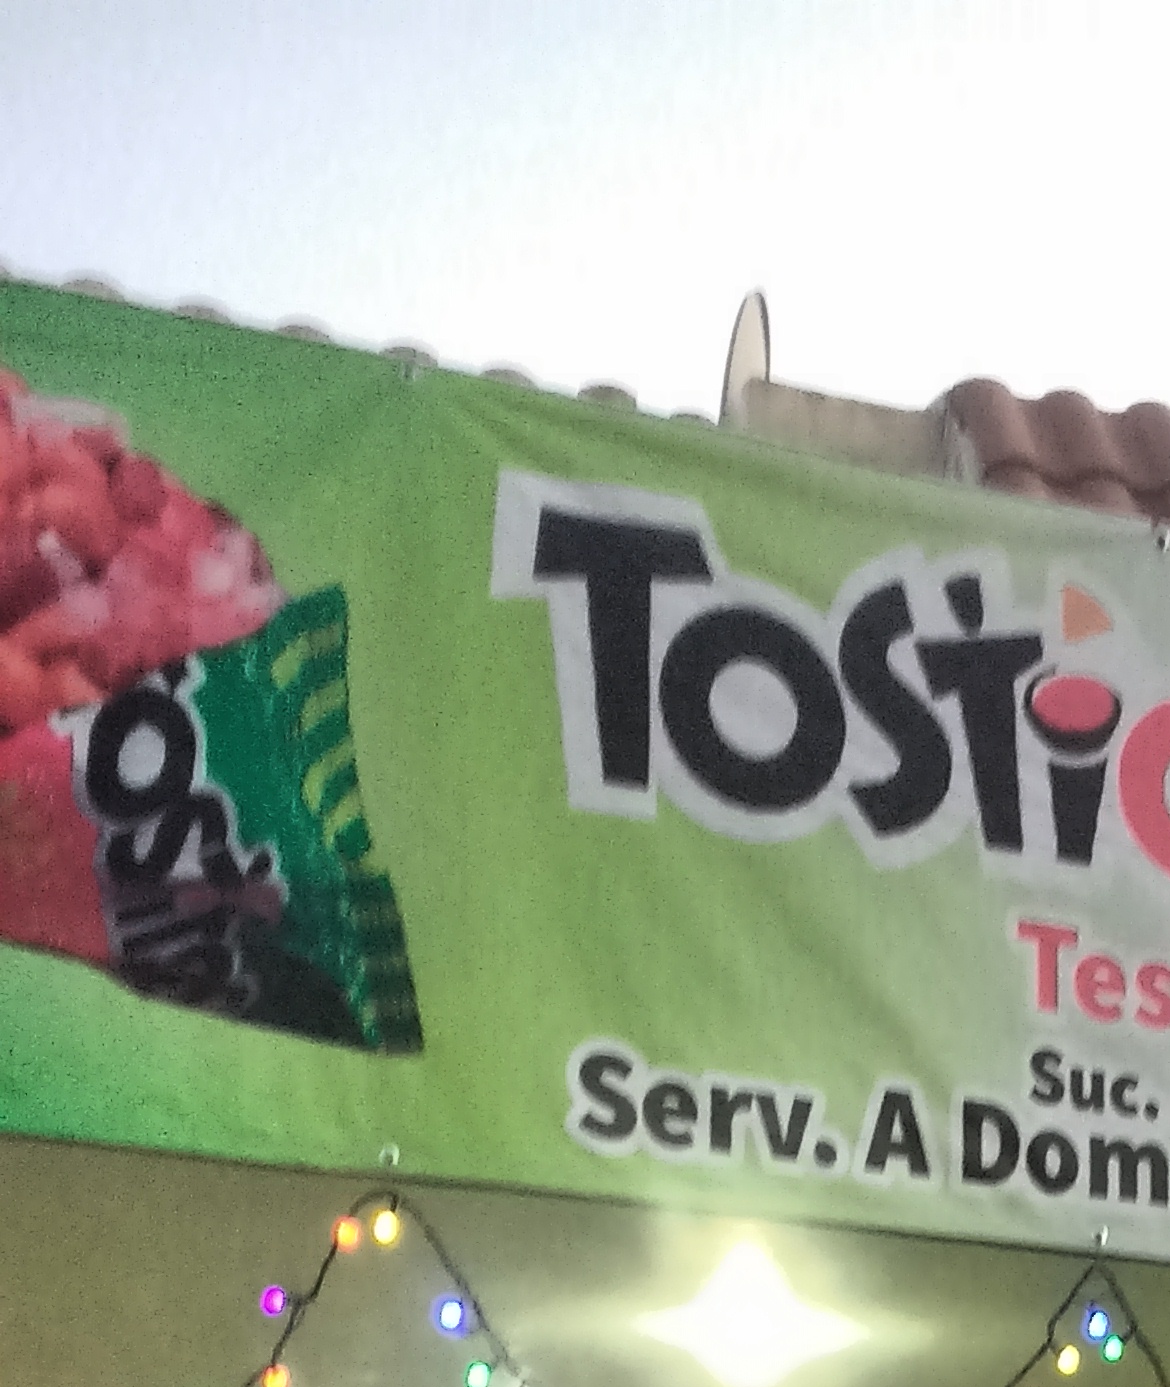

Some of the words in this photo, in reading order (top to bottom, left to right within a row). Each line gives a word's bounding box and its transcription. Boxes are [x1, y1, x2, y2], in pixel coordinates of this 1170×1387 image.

[577, 1053, 839, 1170] Serv.
[864, 1090, 931, 1179] A
[1029, 1048, 1160, 1120] Suc.
